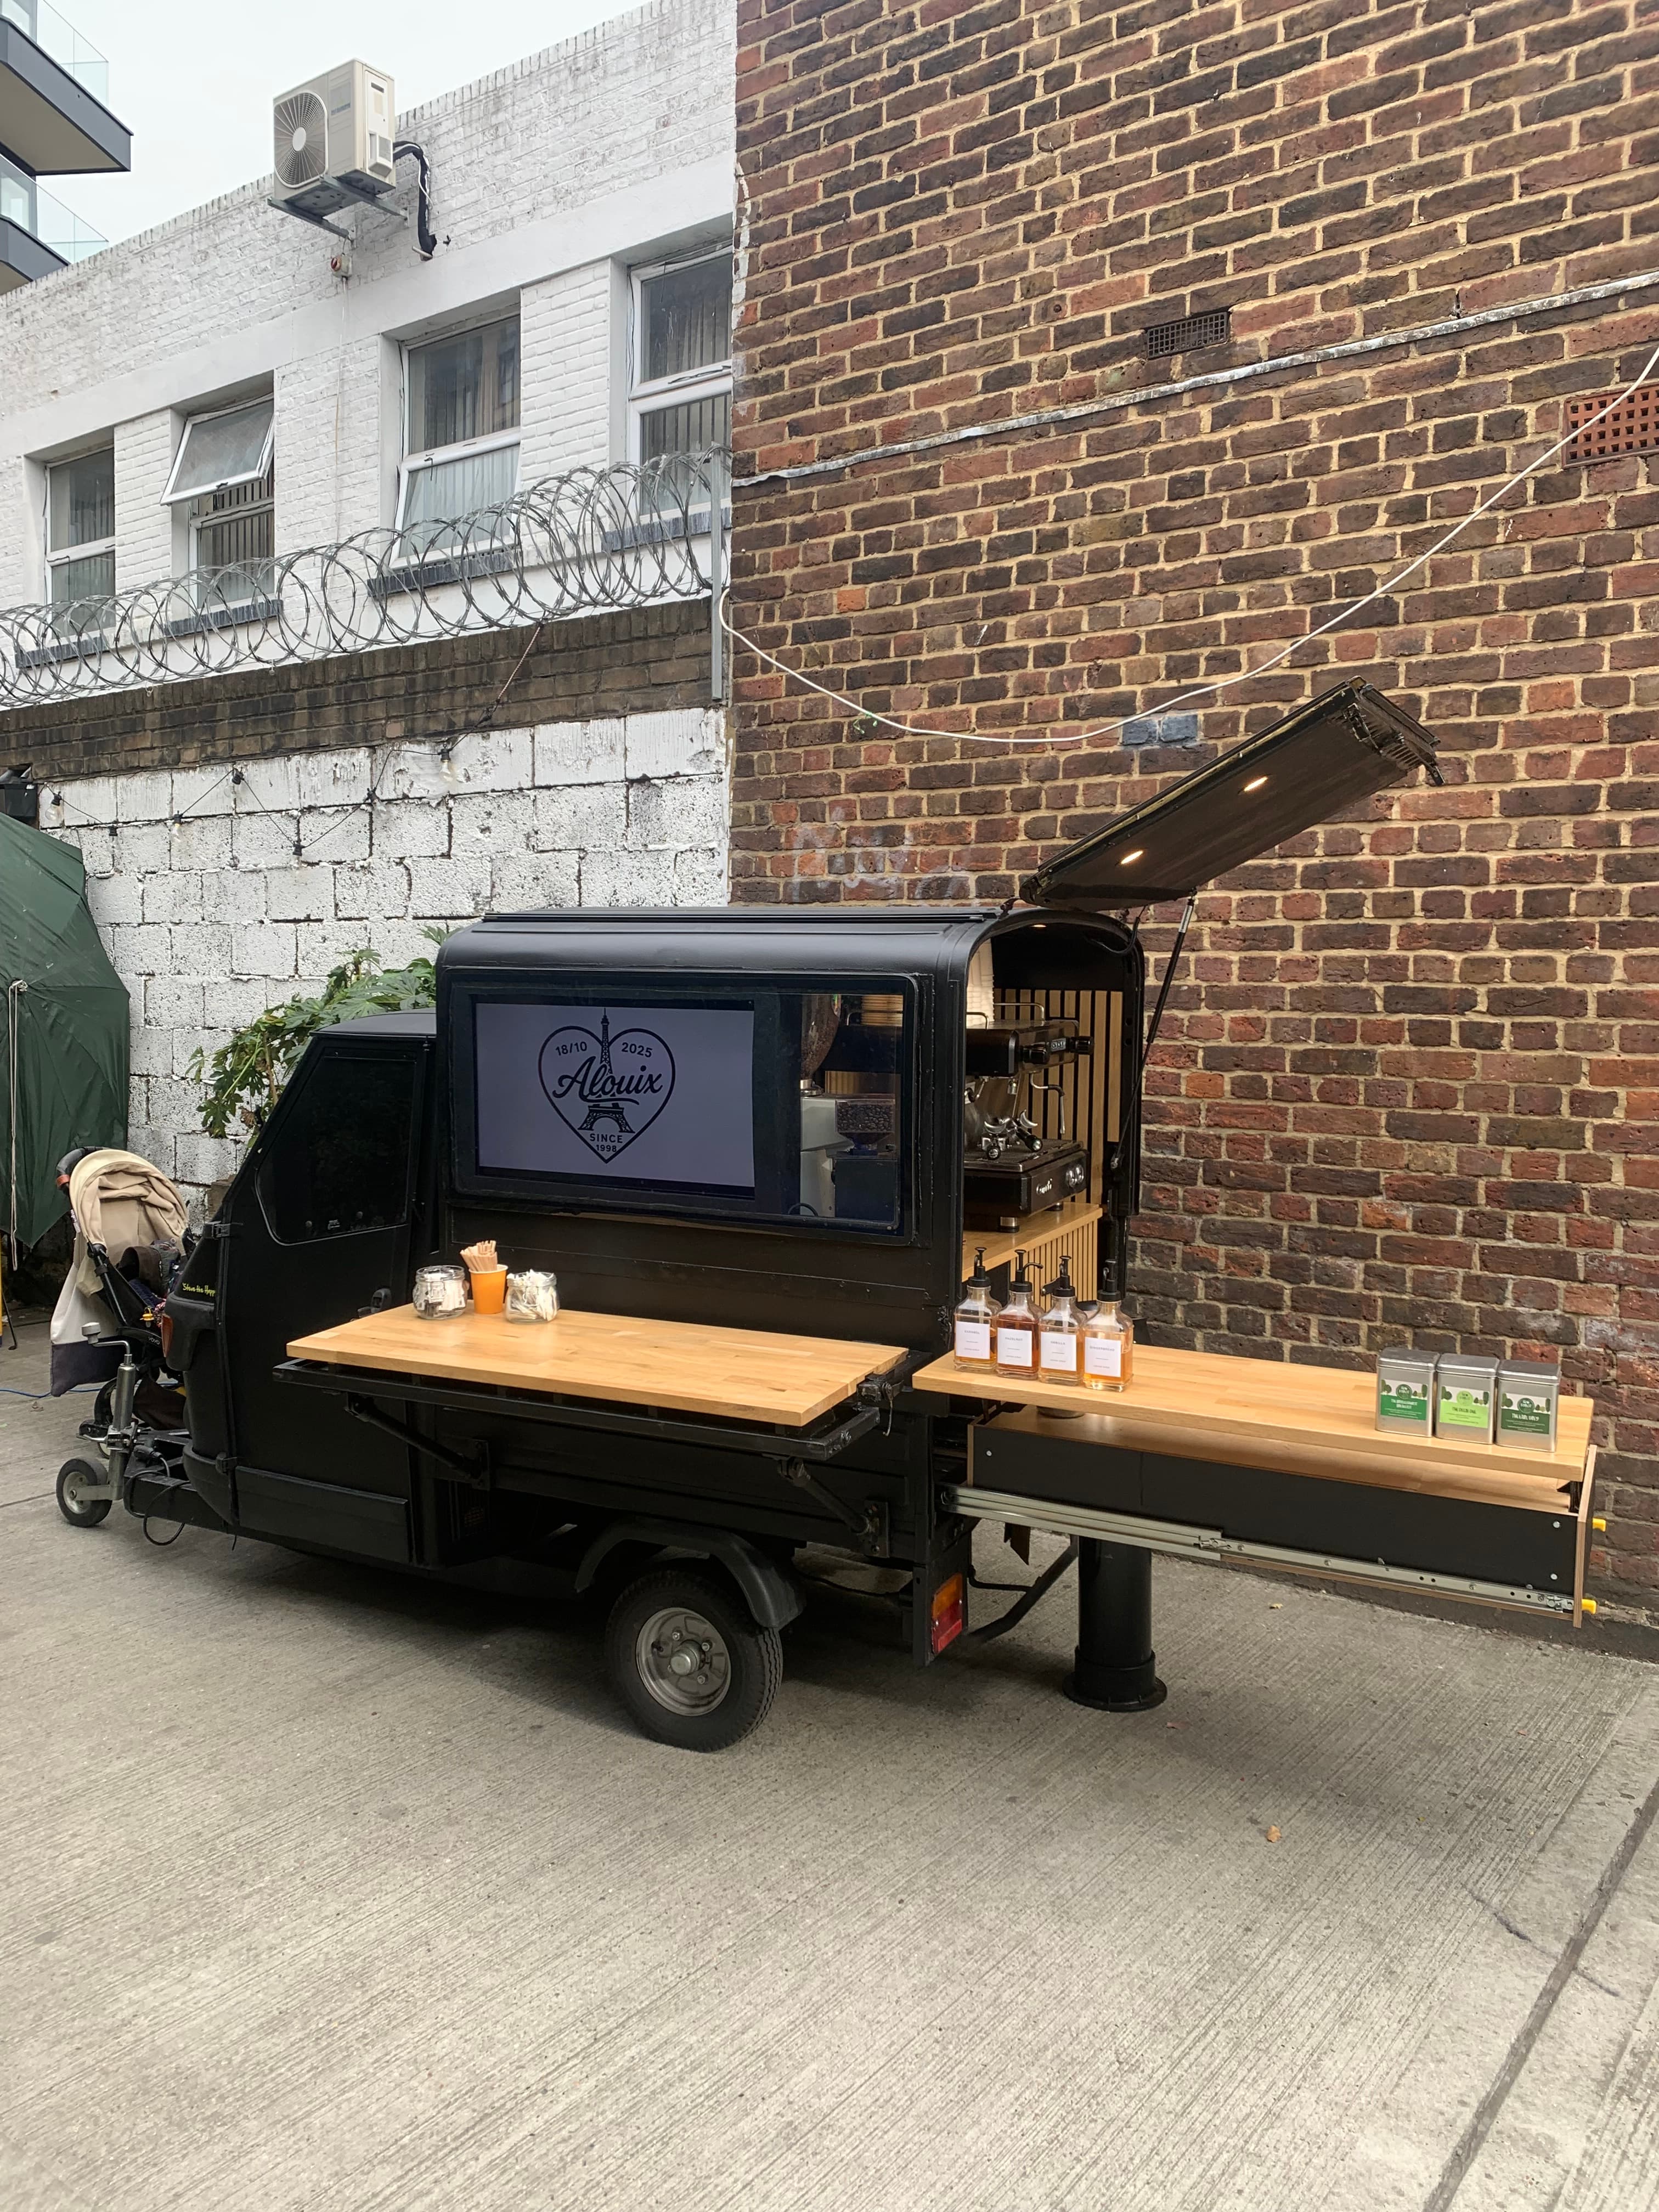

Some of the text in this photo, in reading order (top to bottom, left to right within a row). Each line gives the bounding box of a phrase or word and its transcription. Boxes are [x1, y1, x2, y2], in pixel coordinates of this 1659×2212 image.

[555, 1041, 653, 1058] 18/10 2025
[552, 1056, 663, 1105] Alouix
[589, 1133, 623, 1144] SINCE
[596, 1144, 617, 1153] 1998
